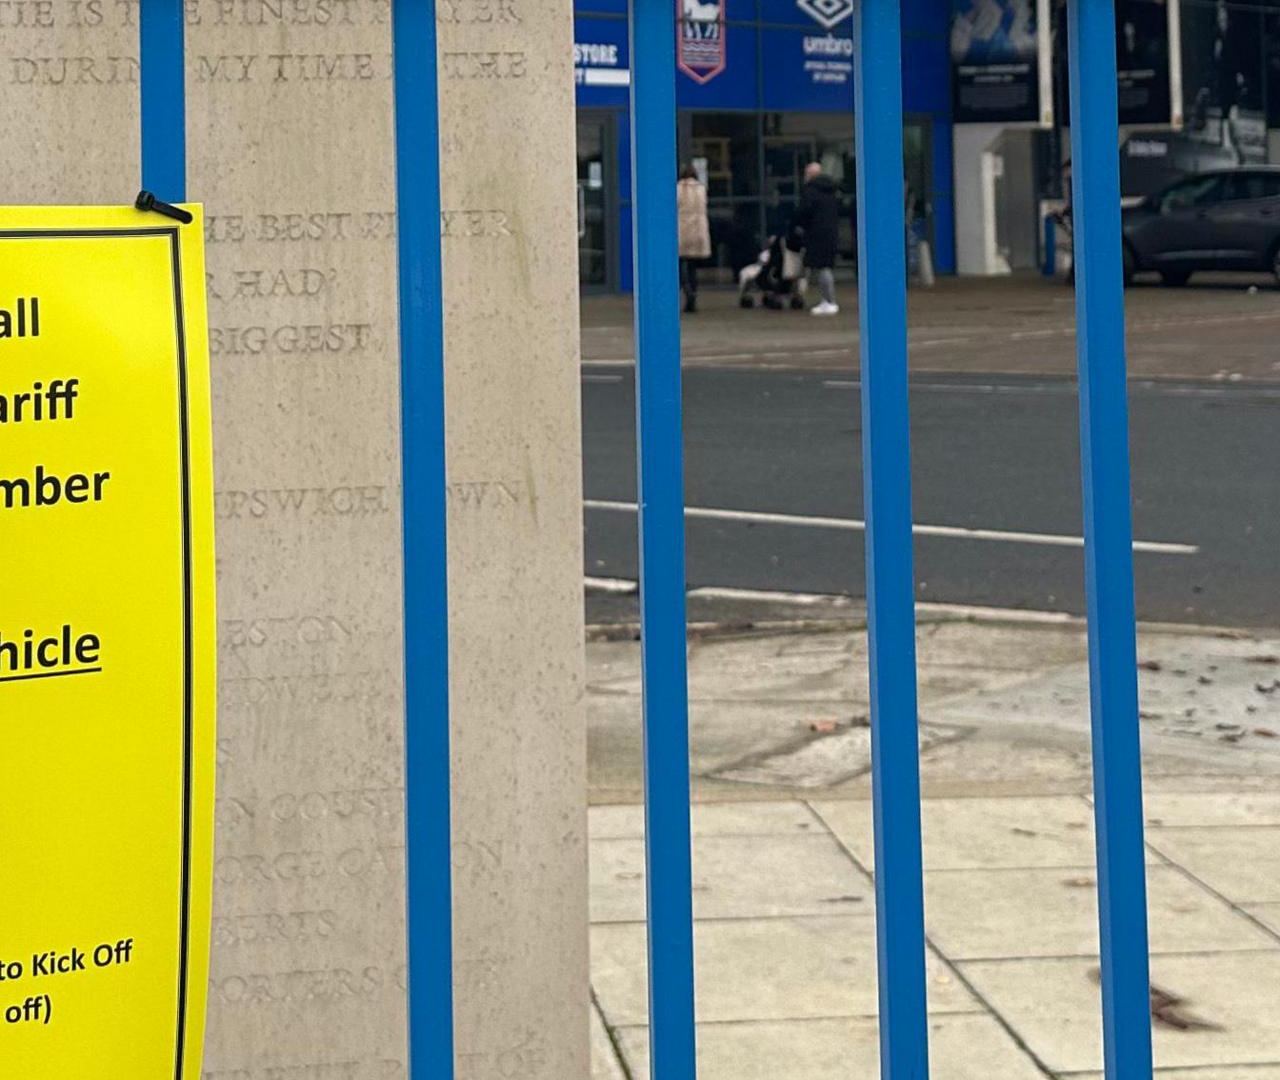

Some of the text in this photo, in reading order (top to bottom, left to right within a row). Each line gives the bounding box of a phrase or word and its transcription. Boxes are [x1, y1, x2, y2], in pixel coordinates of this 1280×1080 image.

[267, 52, 375, 83] TIME
[256, 212, 352, 242] BEST
[32, 946, 86, 978] Kick
[93, 938, 133, 968] Off
[5, 994, 52, 1025] off)
